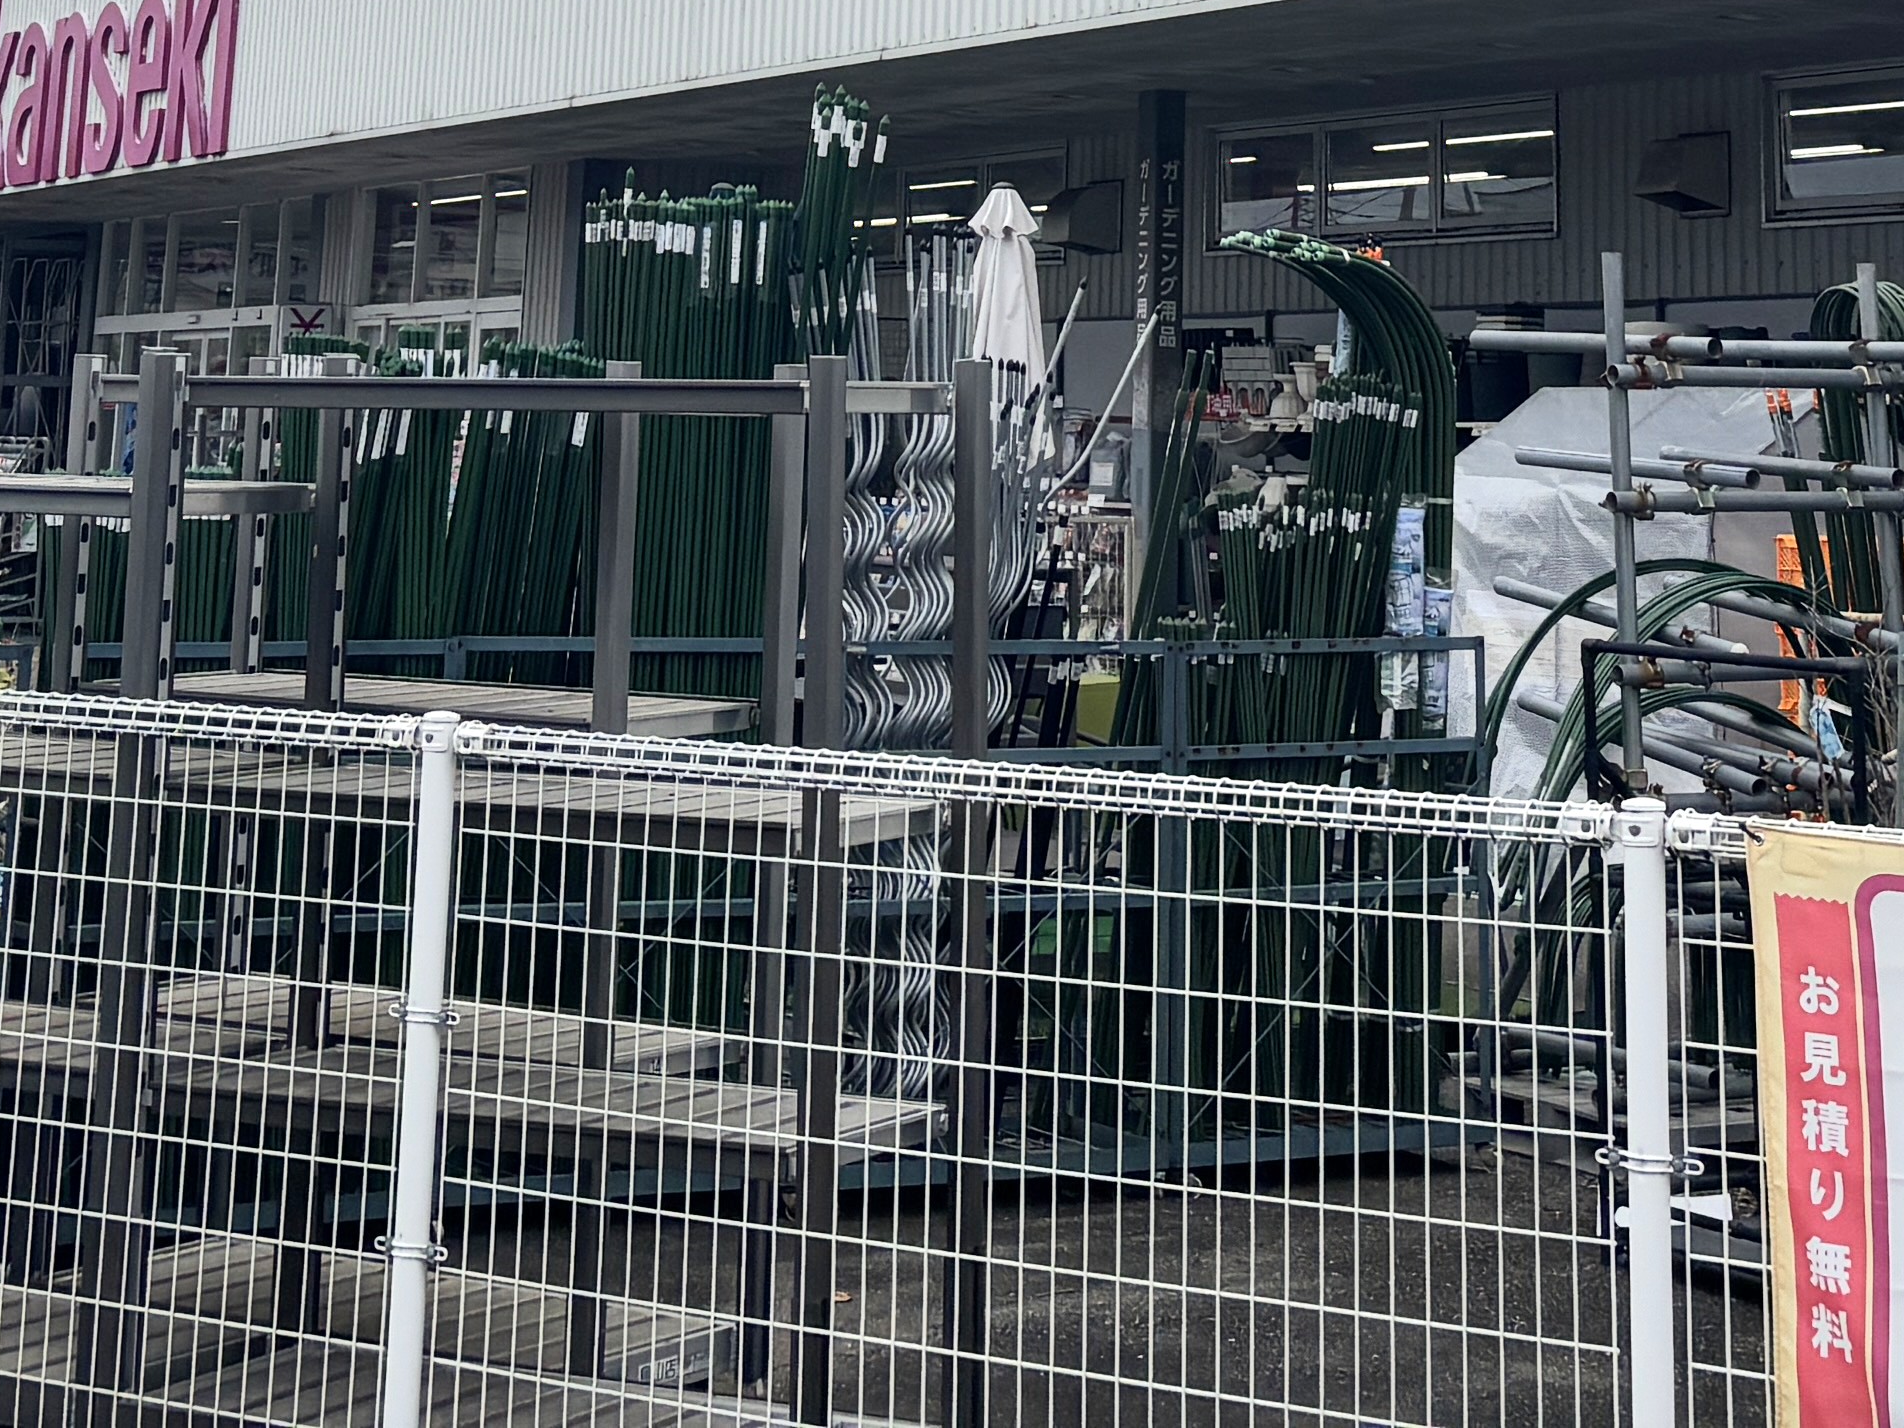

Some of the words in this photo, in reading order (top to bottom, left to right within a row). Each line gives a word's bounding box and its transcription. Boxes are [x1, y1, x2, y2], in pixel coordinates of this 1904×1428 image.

[1158, 160, 1181, 348] ガーデニング用品
[1798, 965, 1853, 1364] お見積り無料
